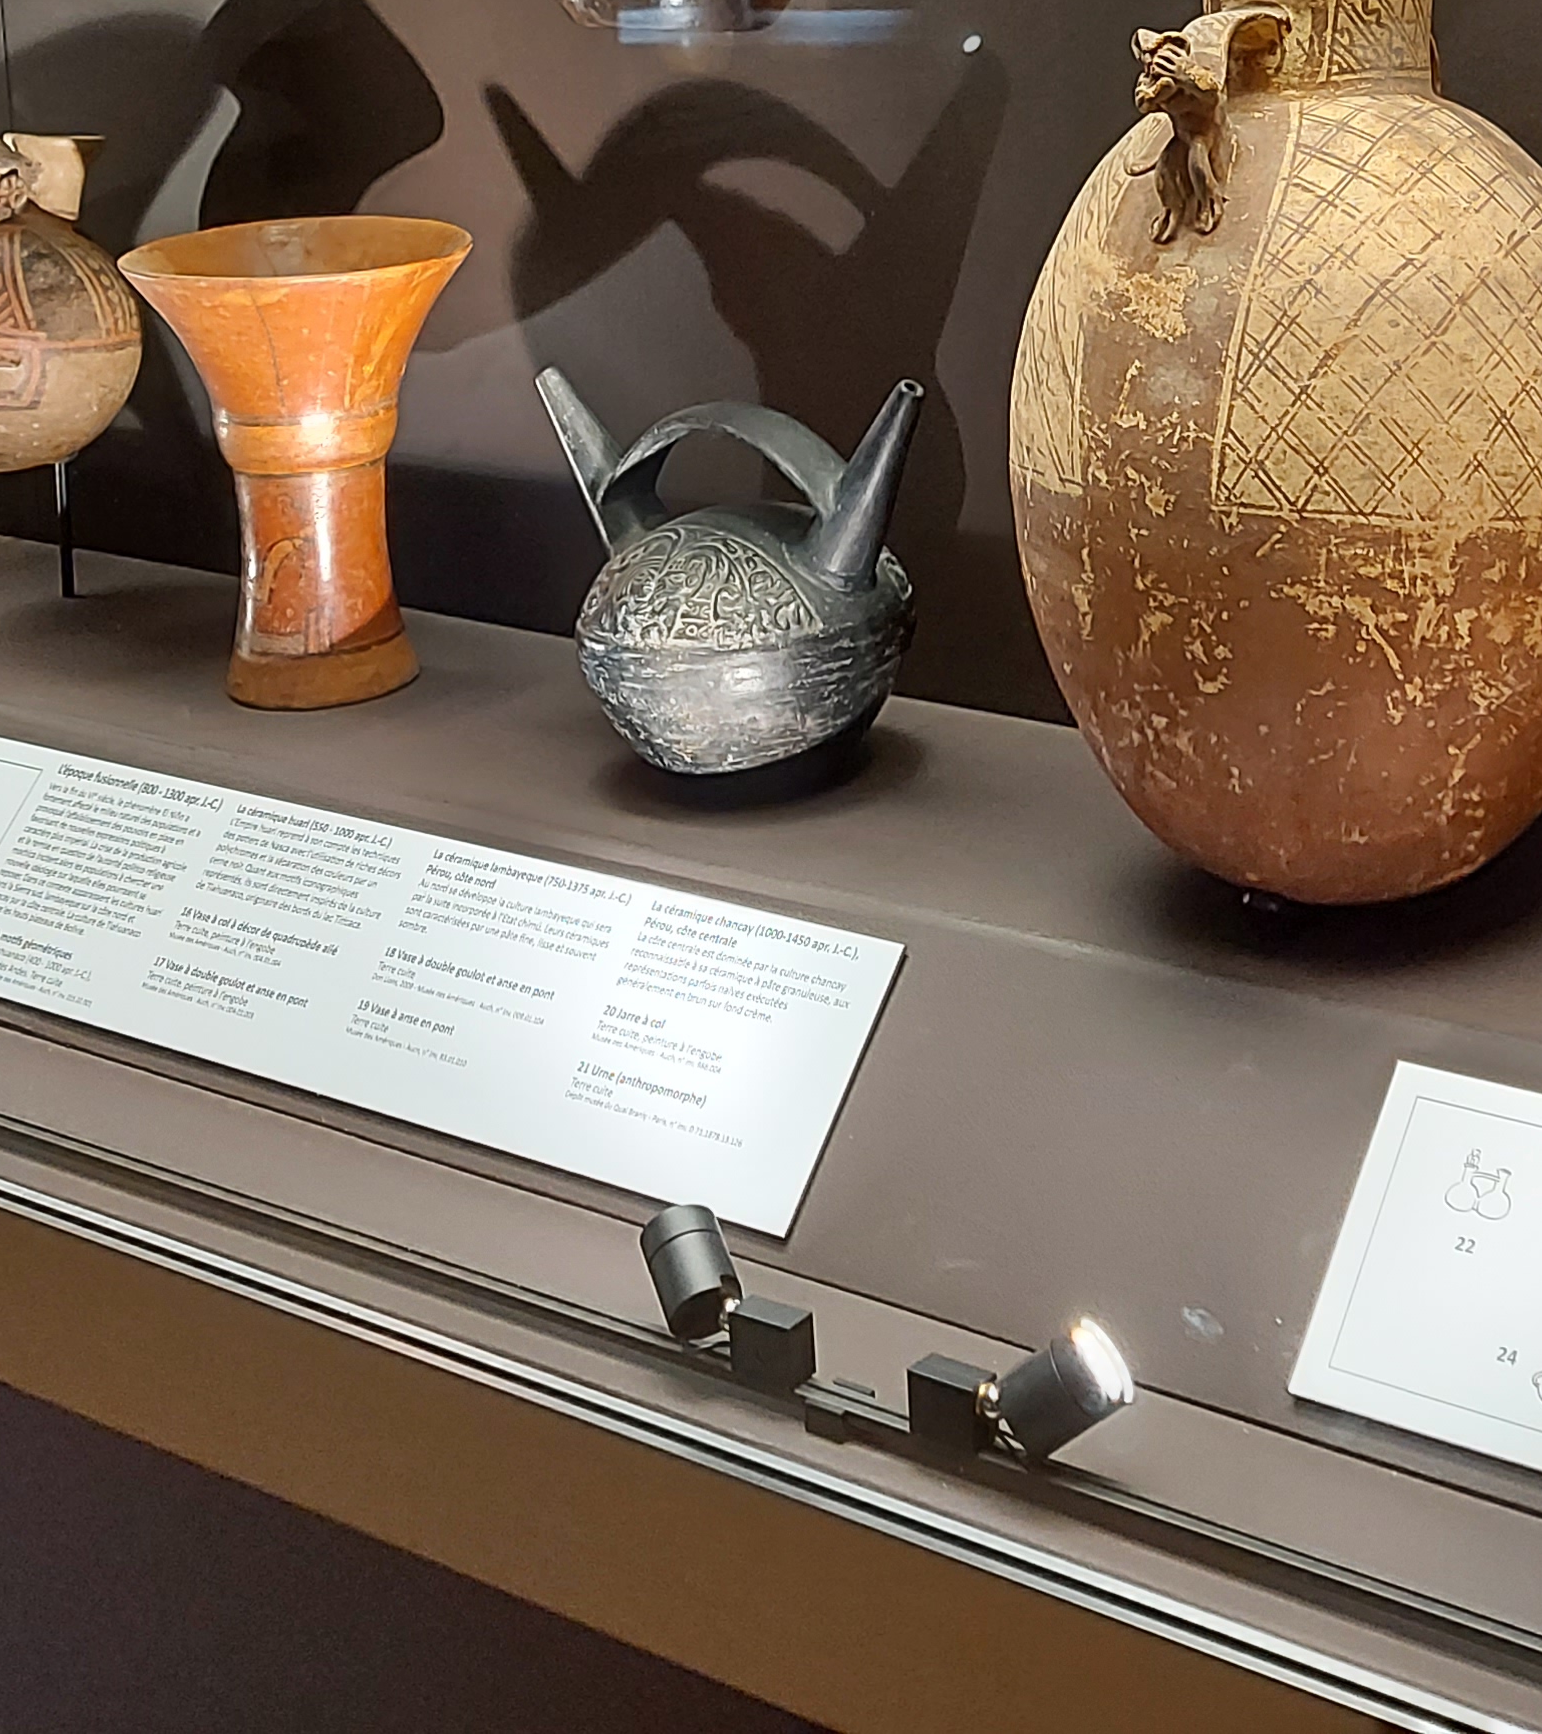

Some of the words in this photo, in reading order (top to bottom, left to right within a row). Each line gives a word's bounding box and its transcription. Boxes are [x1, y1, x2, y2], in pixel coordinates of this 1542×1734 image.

[424, 863, 453, 882] Pérou,
[453, 870, 474, 885] côte
[472, 876, 498, 890] nord
[642, 915, 674, 935] Pérou,
[675, 924, 698, 939] côte
[697, 931, 738, 949] centrale
[602, 1004, 618, 1017] 20
[615, 1007, 642, 1024] Jarre
[640, 1013, 649, 1026] à
[649, 1018, 667, 1029] col
[576, 1060, 591, 1075] 21
[590, 1063, 616, 1082] Urne
[614, 1070, 708, 1110] (anthropomorphe)
[1454, 1236, 1476, 1254] 22
[1496, 1347, 1518, 1366] 24
